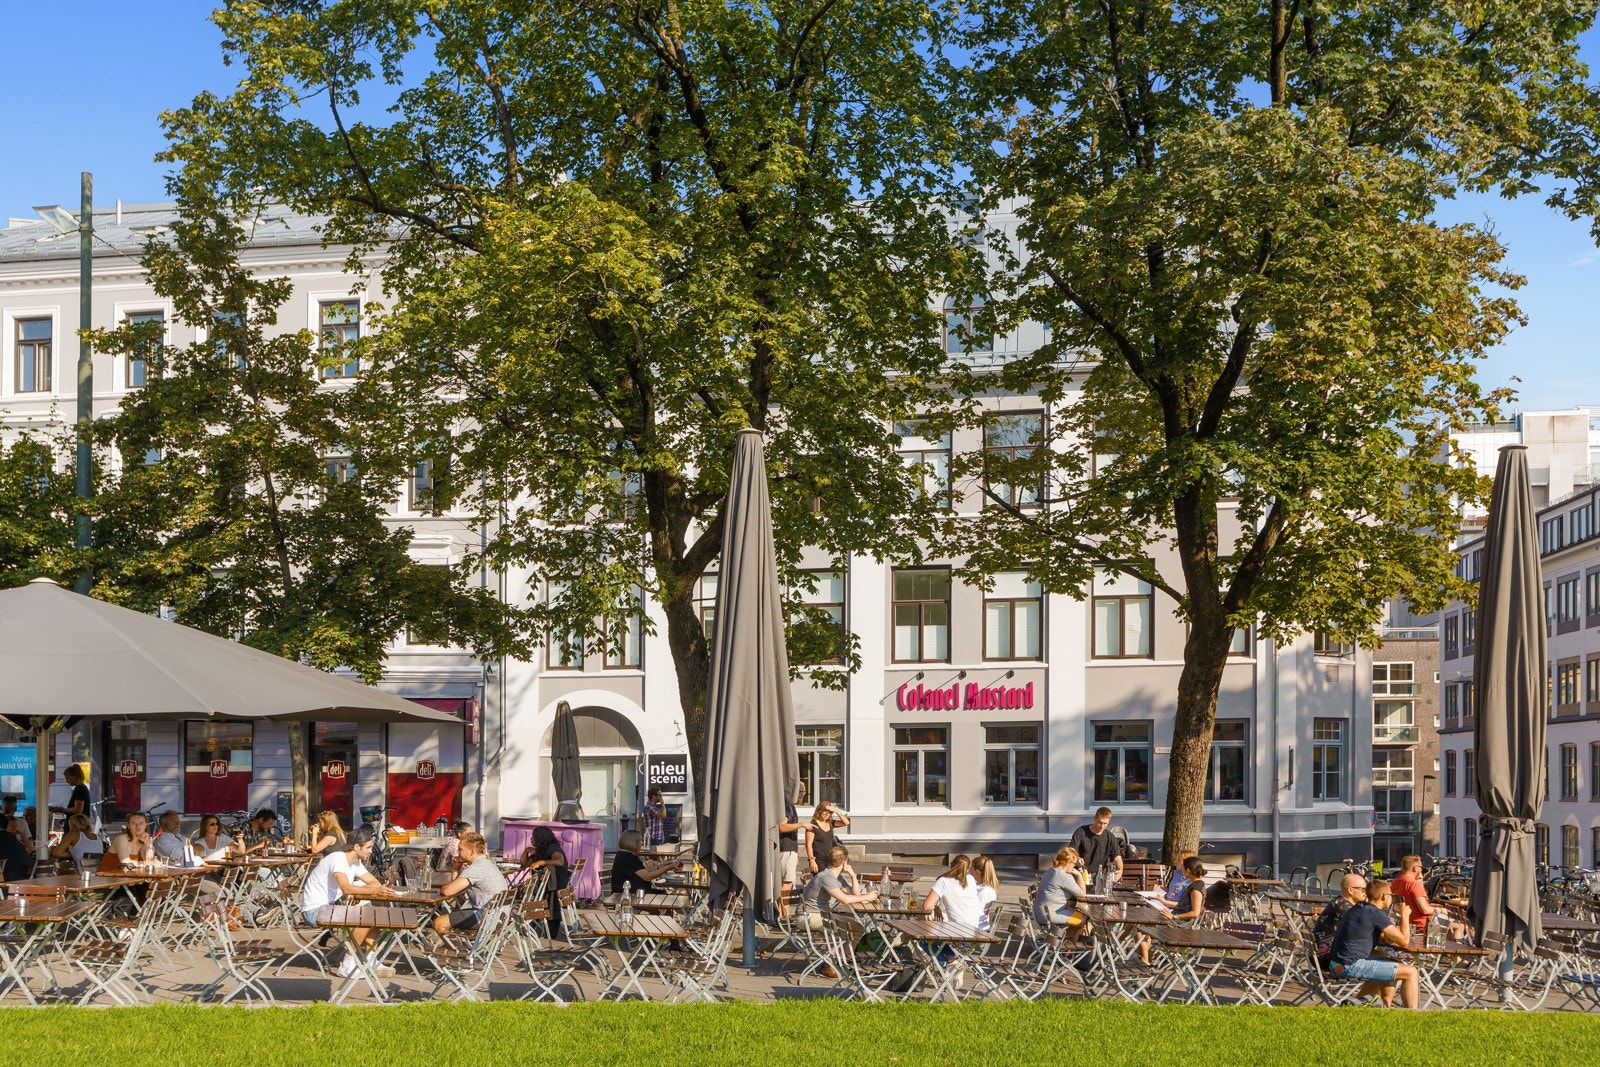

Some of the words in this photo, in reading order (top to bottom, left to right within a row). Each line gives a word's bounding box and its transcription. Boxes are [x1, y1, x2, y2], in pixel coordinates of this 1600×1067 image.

[898, 683, 960, 711] Colonel
[965, 681, 1034, 711] Mustard
[122, 763, 134, 775] deli
[212, 763, 225, 775] deli
[329, 763, 343, 775] deli
[419, 763, 432, 776] deli
[650, 761, 685, 775] nieu
[650, 775, 685, 784] scene
